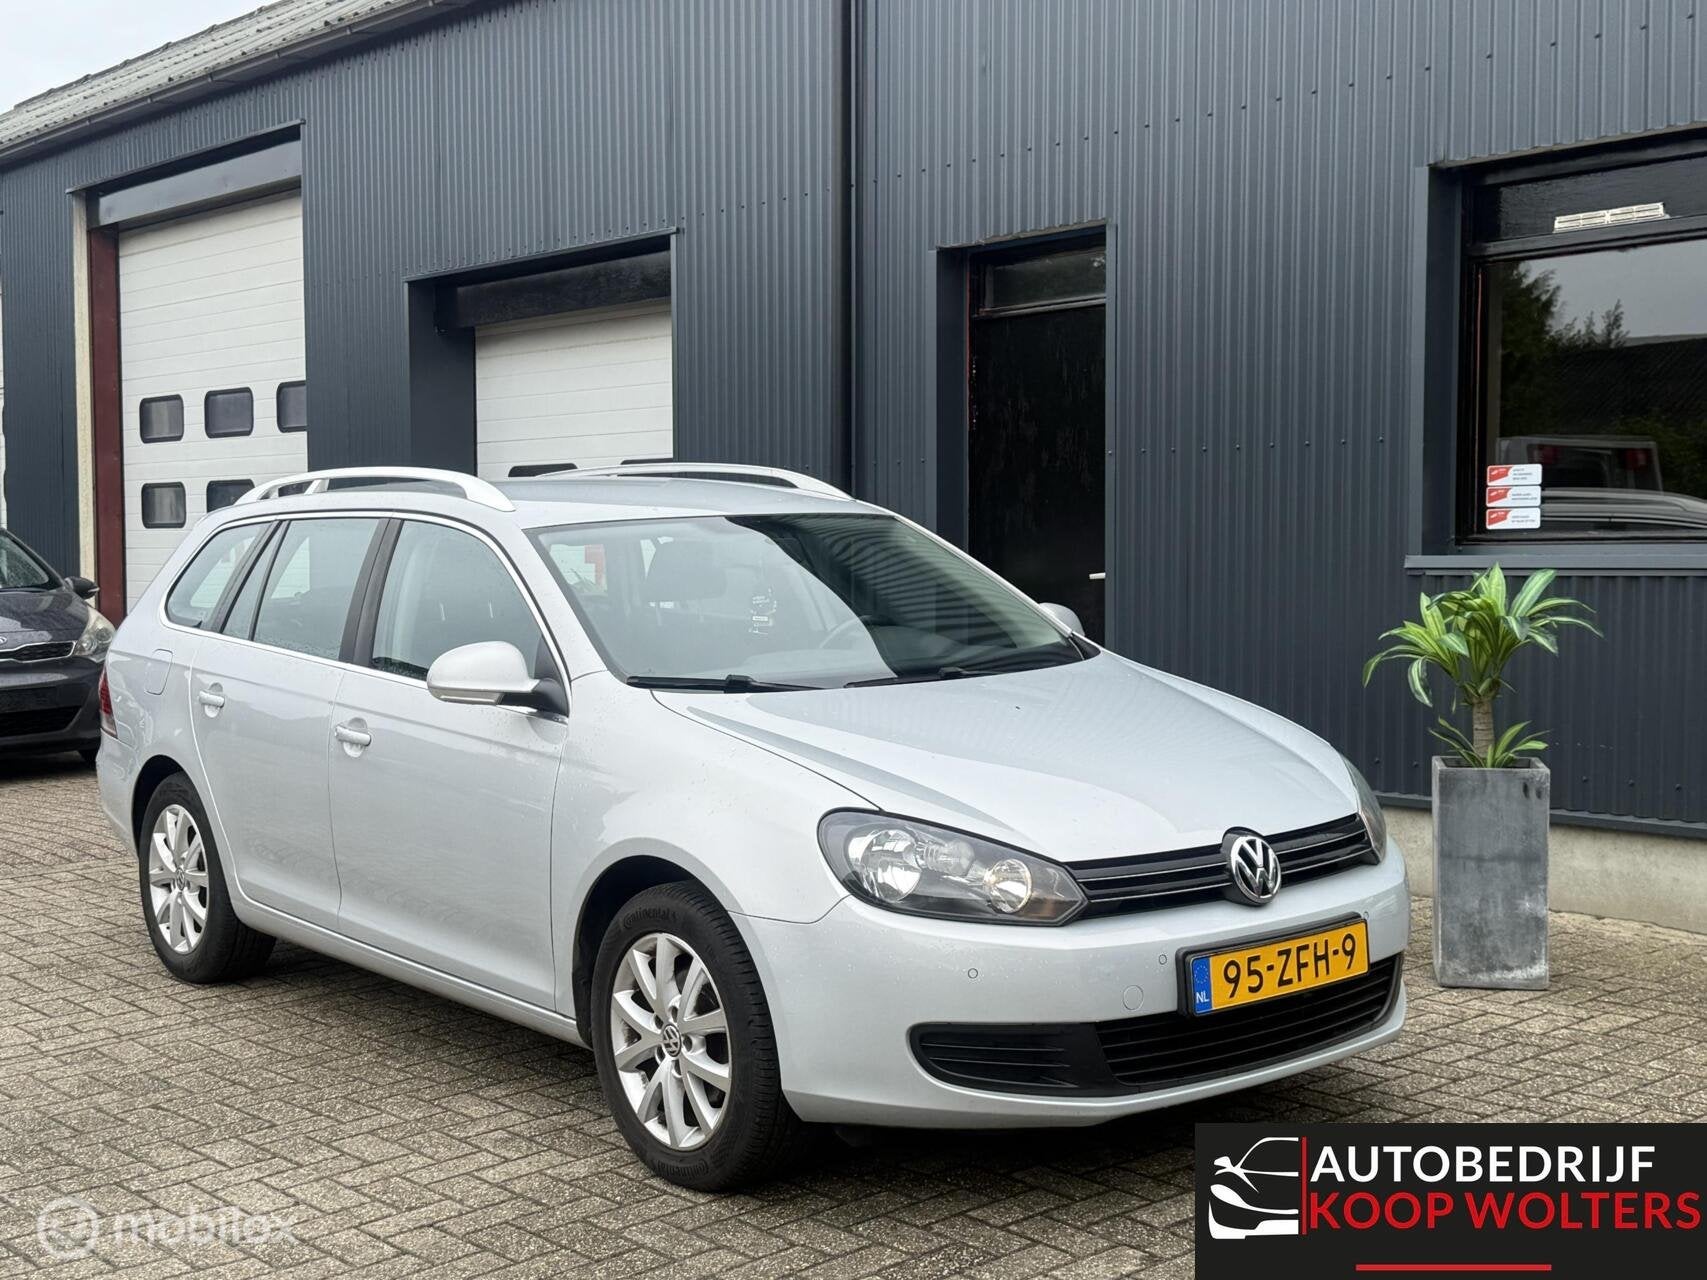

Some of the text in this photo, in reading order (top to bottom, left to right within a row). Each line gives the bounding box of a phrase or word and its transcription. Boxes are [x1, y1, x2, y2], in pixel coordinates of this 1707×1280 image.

[1231, 836, 1281, 903] VW
[1196, 993, 1210, 1003] NL
[1223, 933, 1357, 998] 95-ZFH-9
